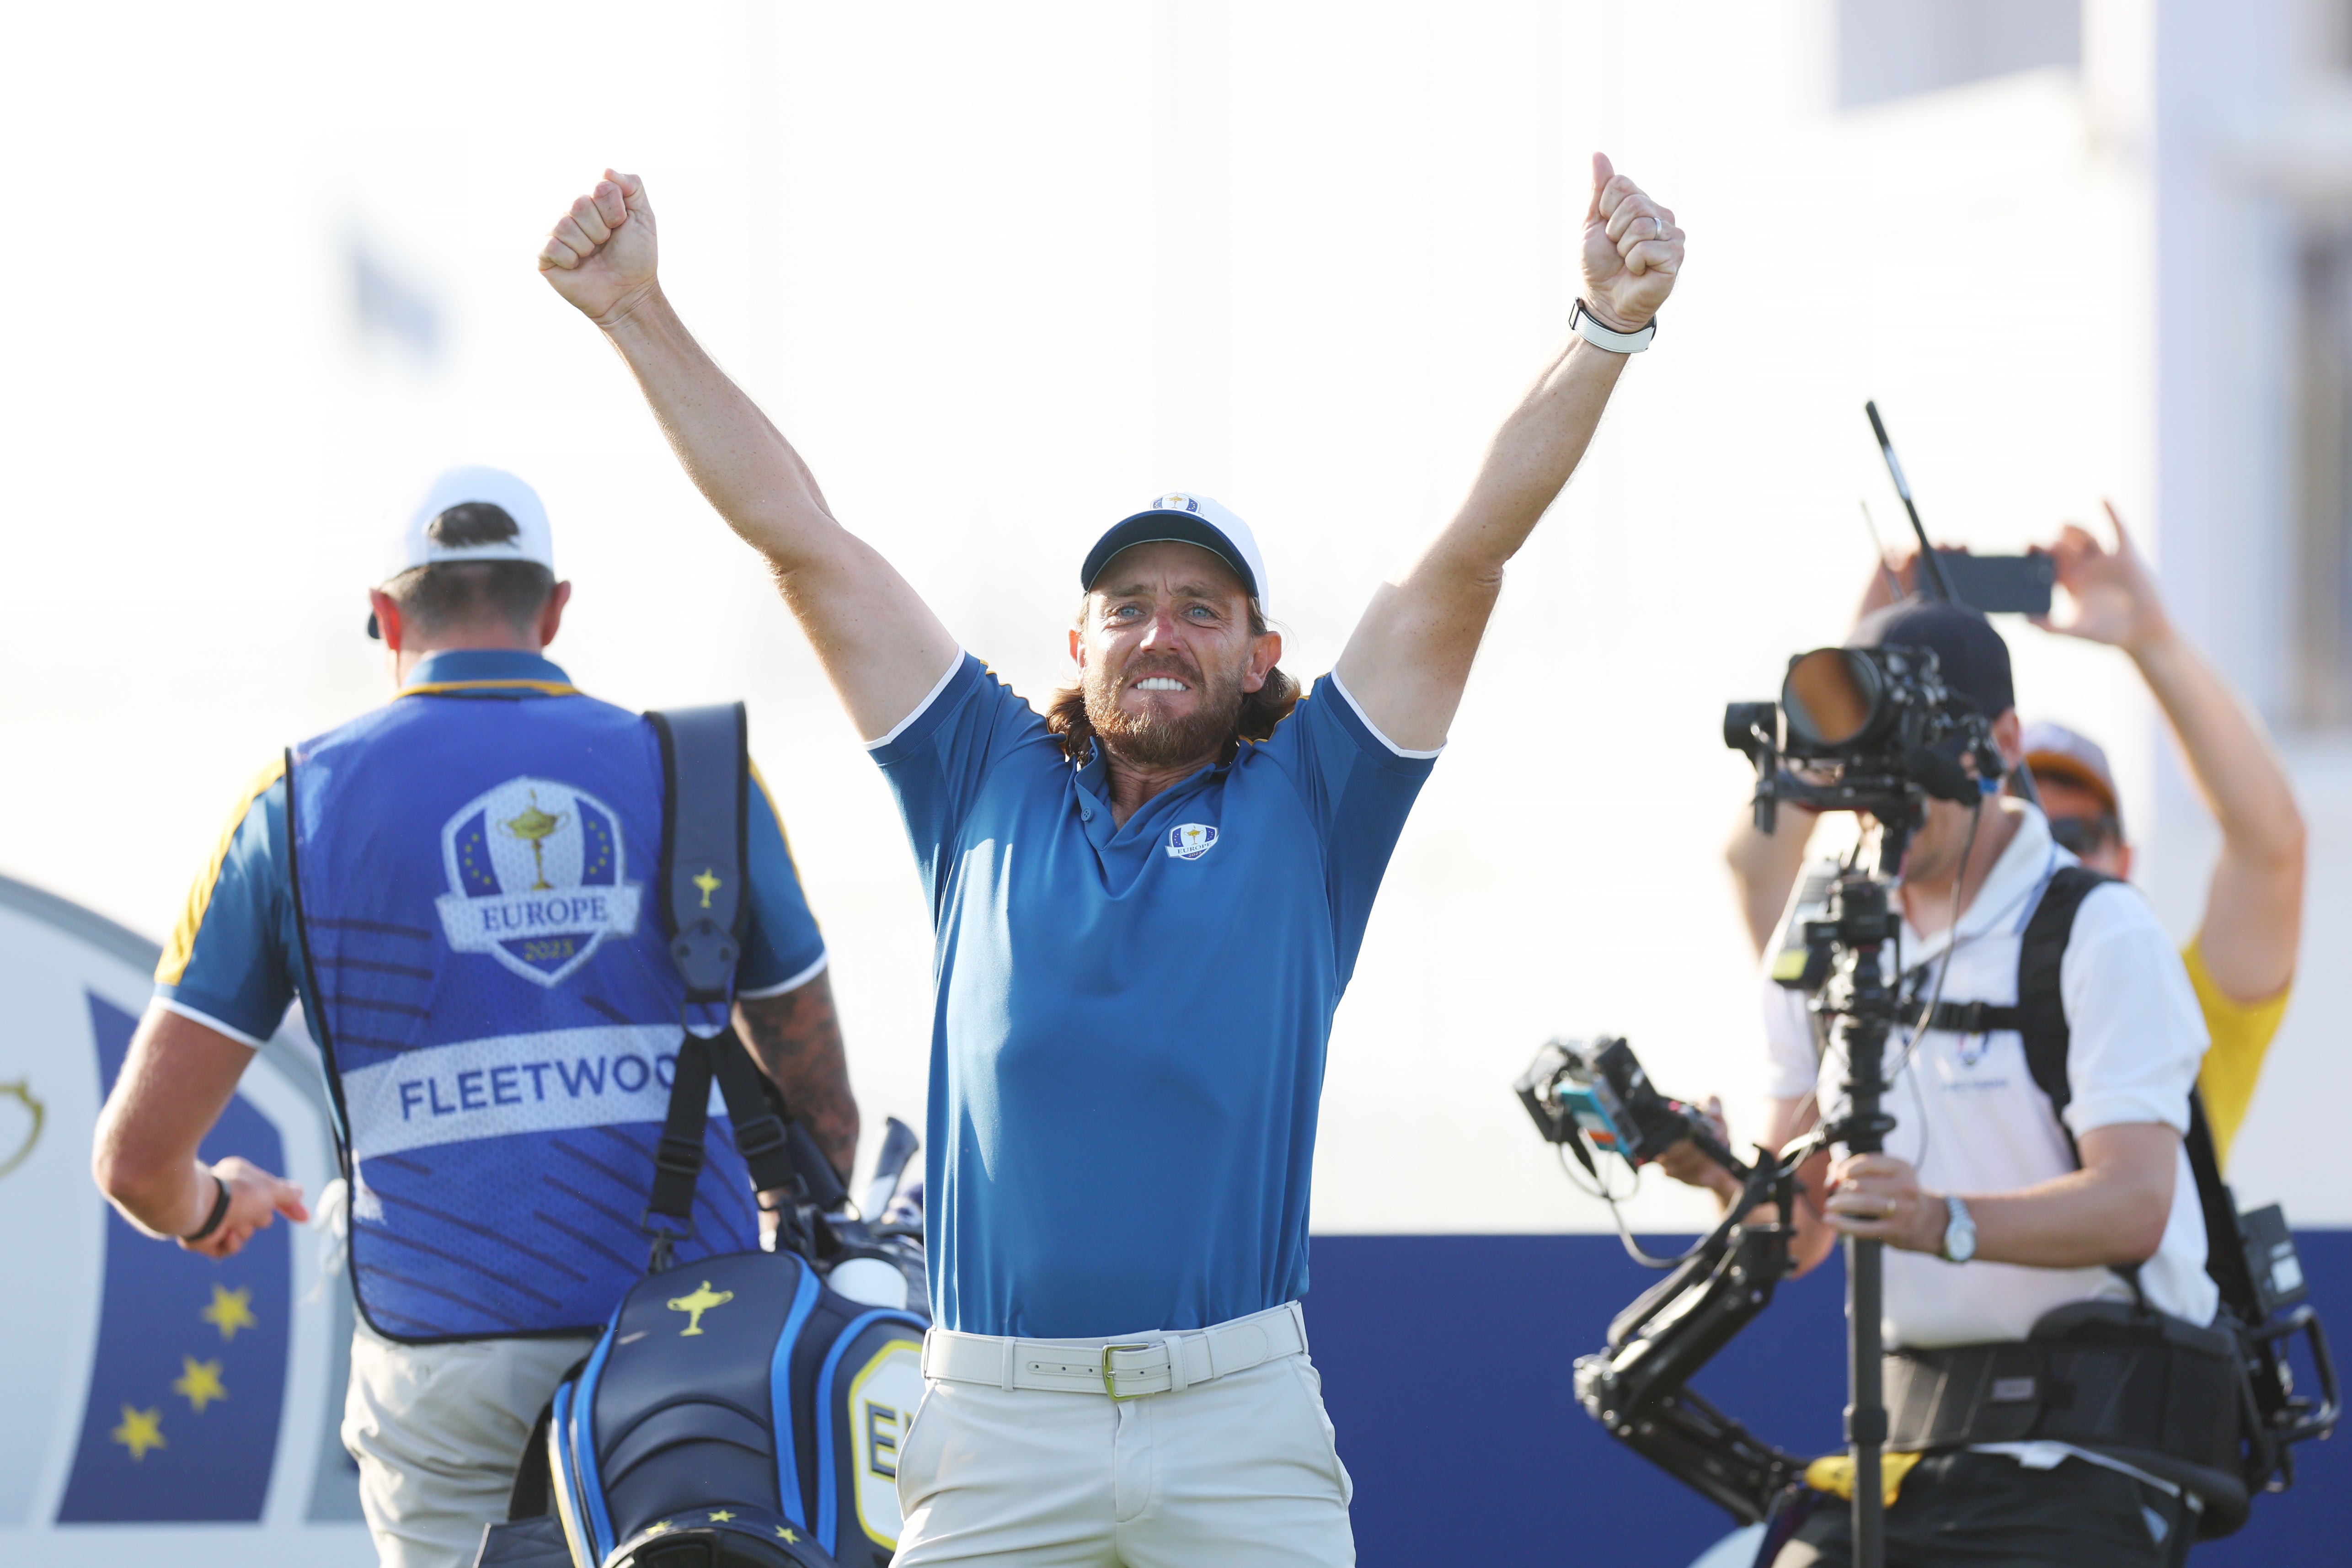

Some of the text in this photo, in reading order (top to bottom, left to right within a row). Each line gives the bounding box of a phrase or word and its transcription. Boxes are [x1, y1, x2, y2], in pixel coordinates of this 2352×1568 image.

[1178, 843, 1211, 854] EUROPE
[481, 897, 609, 931] EUROPE
[524, 939, 574, 961] 2023
